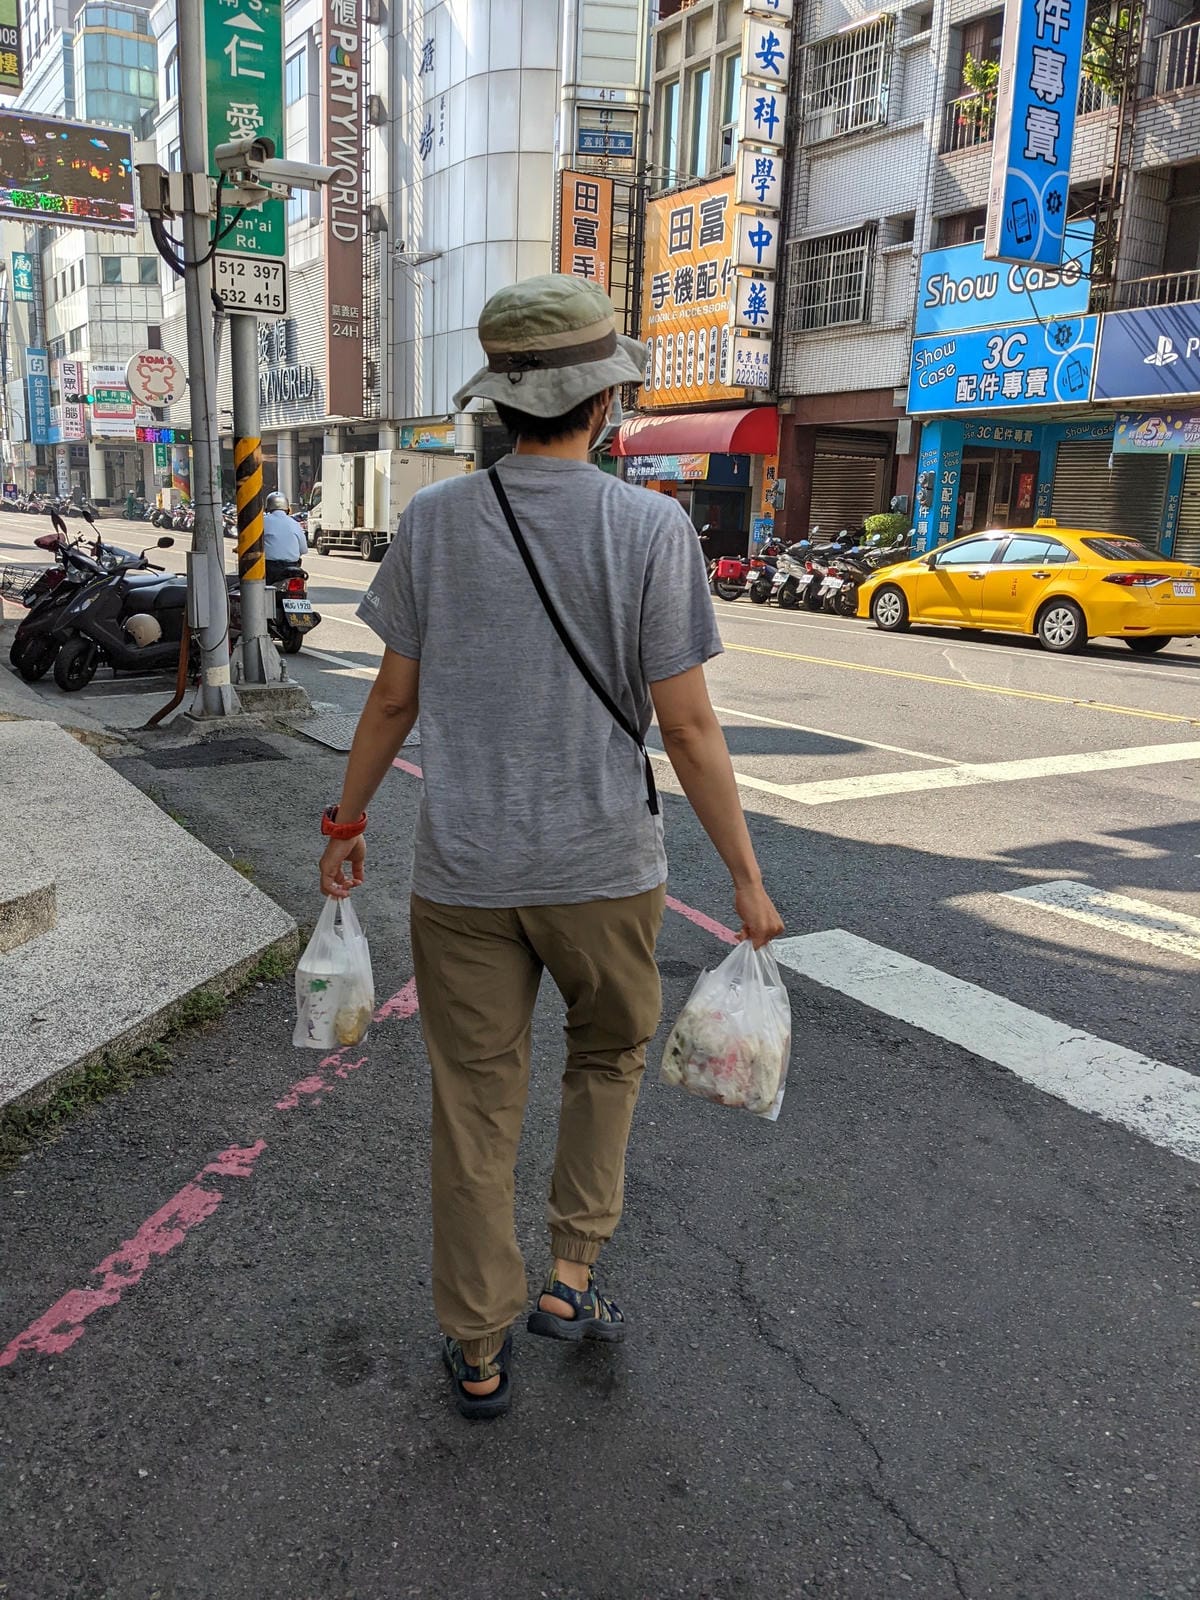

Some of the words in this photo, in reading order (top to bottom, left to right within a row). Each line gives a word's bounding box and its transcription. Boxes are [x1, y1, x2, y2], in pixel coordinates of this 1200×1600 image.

[0, 28, 17, 46] 08
[743, 0, 785, 326] 安科學中藥
[224, 214, 272, 233] Ren'ai
[669, 193, 729, 257] 田富
[236, 234, 261, 249] Rd.
[219, 261, 245, 276] 512
[253, 265, 280, 280] 397
[925, 264, 999, 309] Show
[219, 288, 246, 304] 532
[254, 292, 281, 307] 415
[331, 304, 359, 318] 嘉義店
[649, 310, 678, 325] MOBILE
[679, 301, 730, 319] ACCESSOR
[332, 322, 359, 338] 24H
[915, 340, 957, 371] Show
[982, 331, 1028, 371] 3C
[1186, 337, 1200, 358] P
[138, 355, 174, 365] TOM'S
[736, 368, 769, 386] 2223166
[919, 362, 956, 389] Case
[63, 363, 79, 419] 民眾腦
[955, 367, 1049, 404] 配件專賣
[976, 426, 992, 439] 3C
[993, 427, 1033, 443] 配件專賣
[1065, 424, 1091, 439] Show
[1091, 423, 1114, 438] Case
[920, 449, 938, 460] Show
[922, 458, 938, 467] Case
[942, 450, 960, 460] Show
[944, 459, 959, 468] Case
[941, 470, 957, 484] 3C
[1039, 483, 1051, 494] 3C
